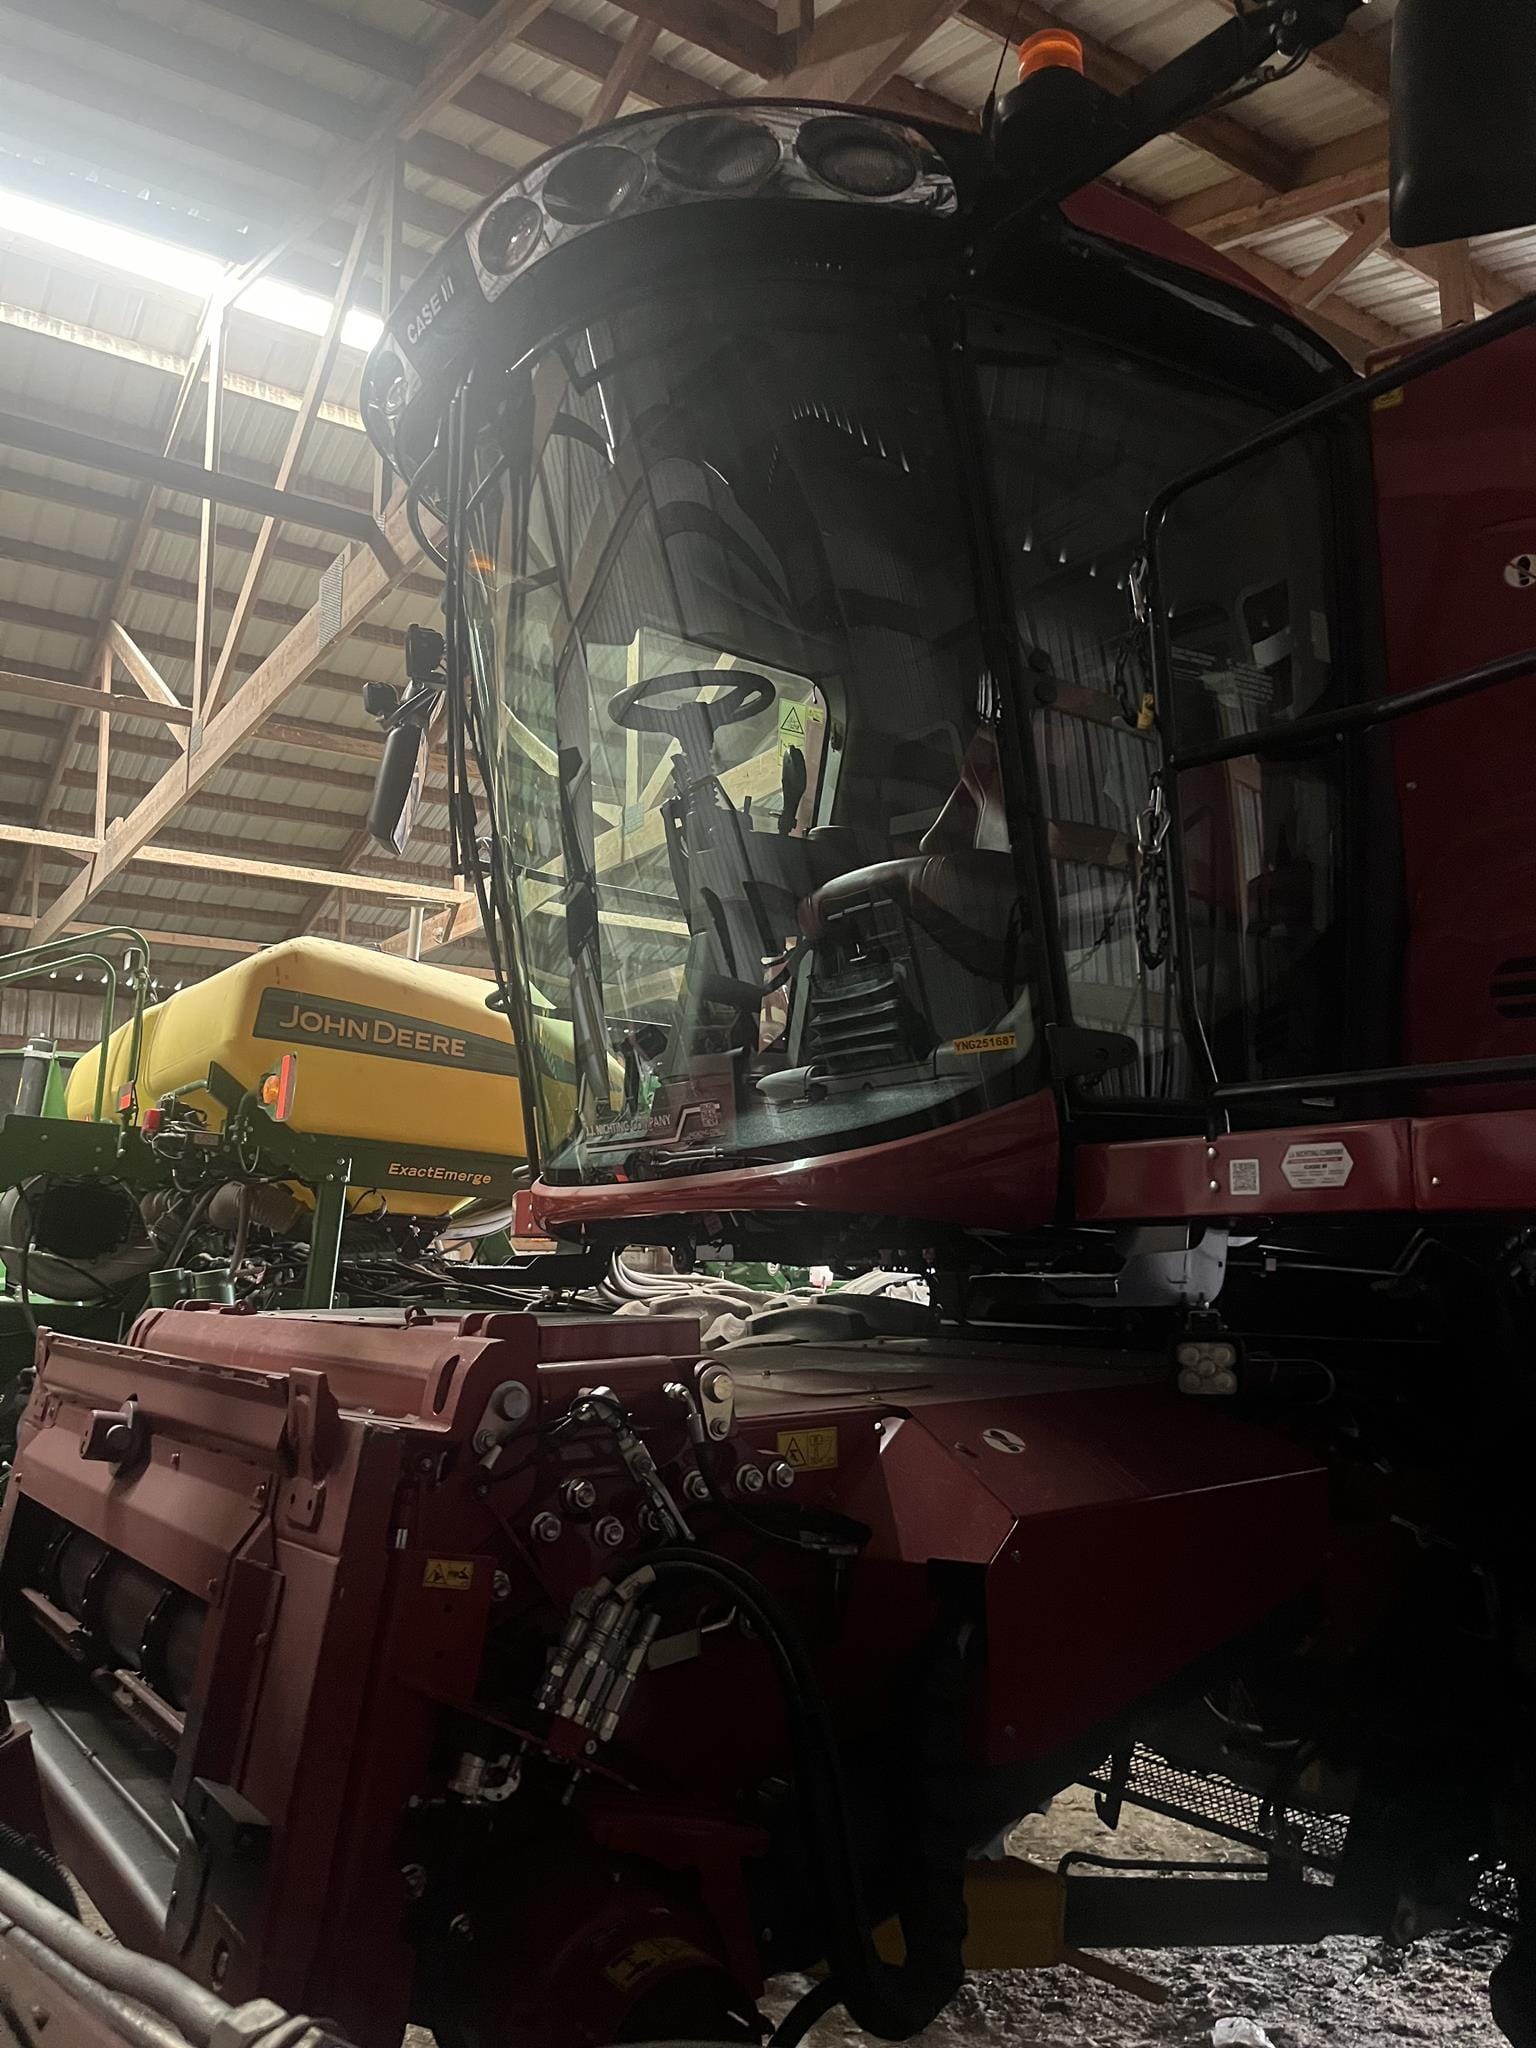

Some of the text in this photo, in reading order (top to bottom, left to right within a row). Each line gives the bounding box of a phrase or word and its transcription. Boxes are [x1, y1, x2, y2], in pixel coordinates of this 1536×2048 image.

[407, 292, 442, 345] CASE
[280, 1005, 467, 1058] JOHN DEERE
[954, 1036, 1015, 1051] YNG251687
[388, 1163, 492, 1186] ExactEmerge
